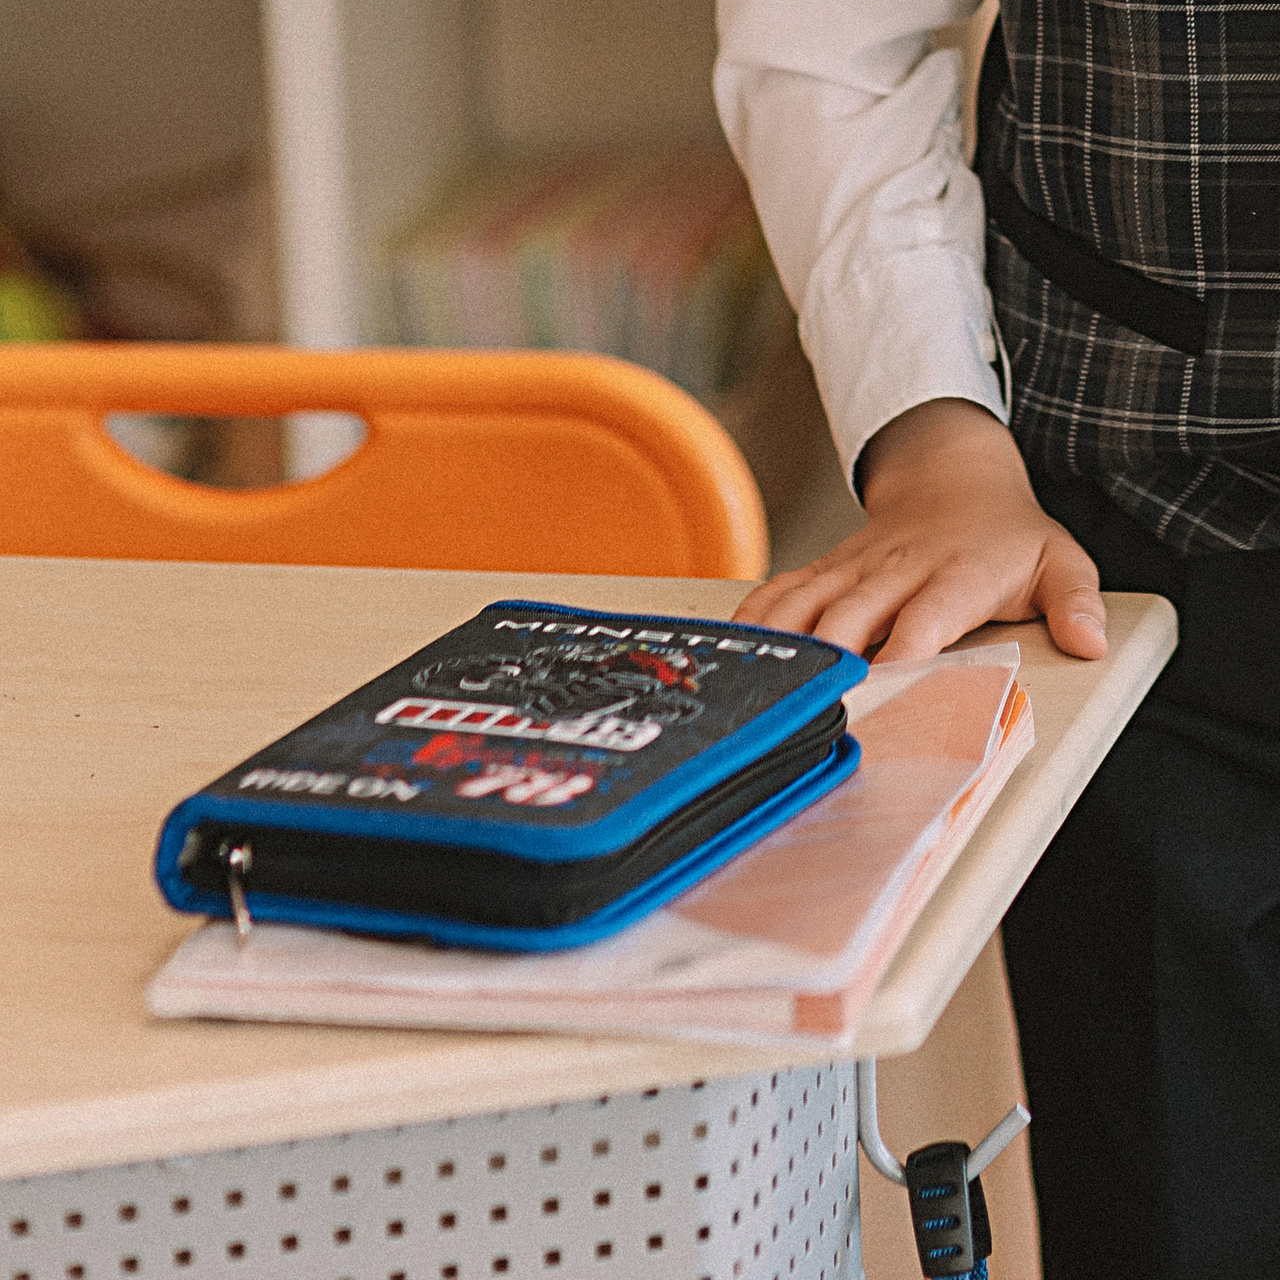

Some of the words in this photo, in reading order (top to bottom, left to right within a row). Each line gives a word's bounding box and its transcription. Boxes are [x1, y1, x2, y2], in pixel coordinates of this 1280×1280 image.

[494, 620, 797, 660] MONSTER
[238, 768, 348, 795] RIDE
[347, 776, 421, 802] ON
